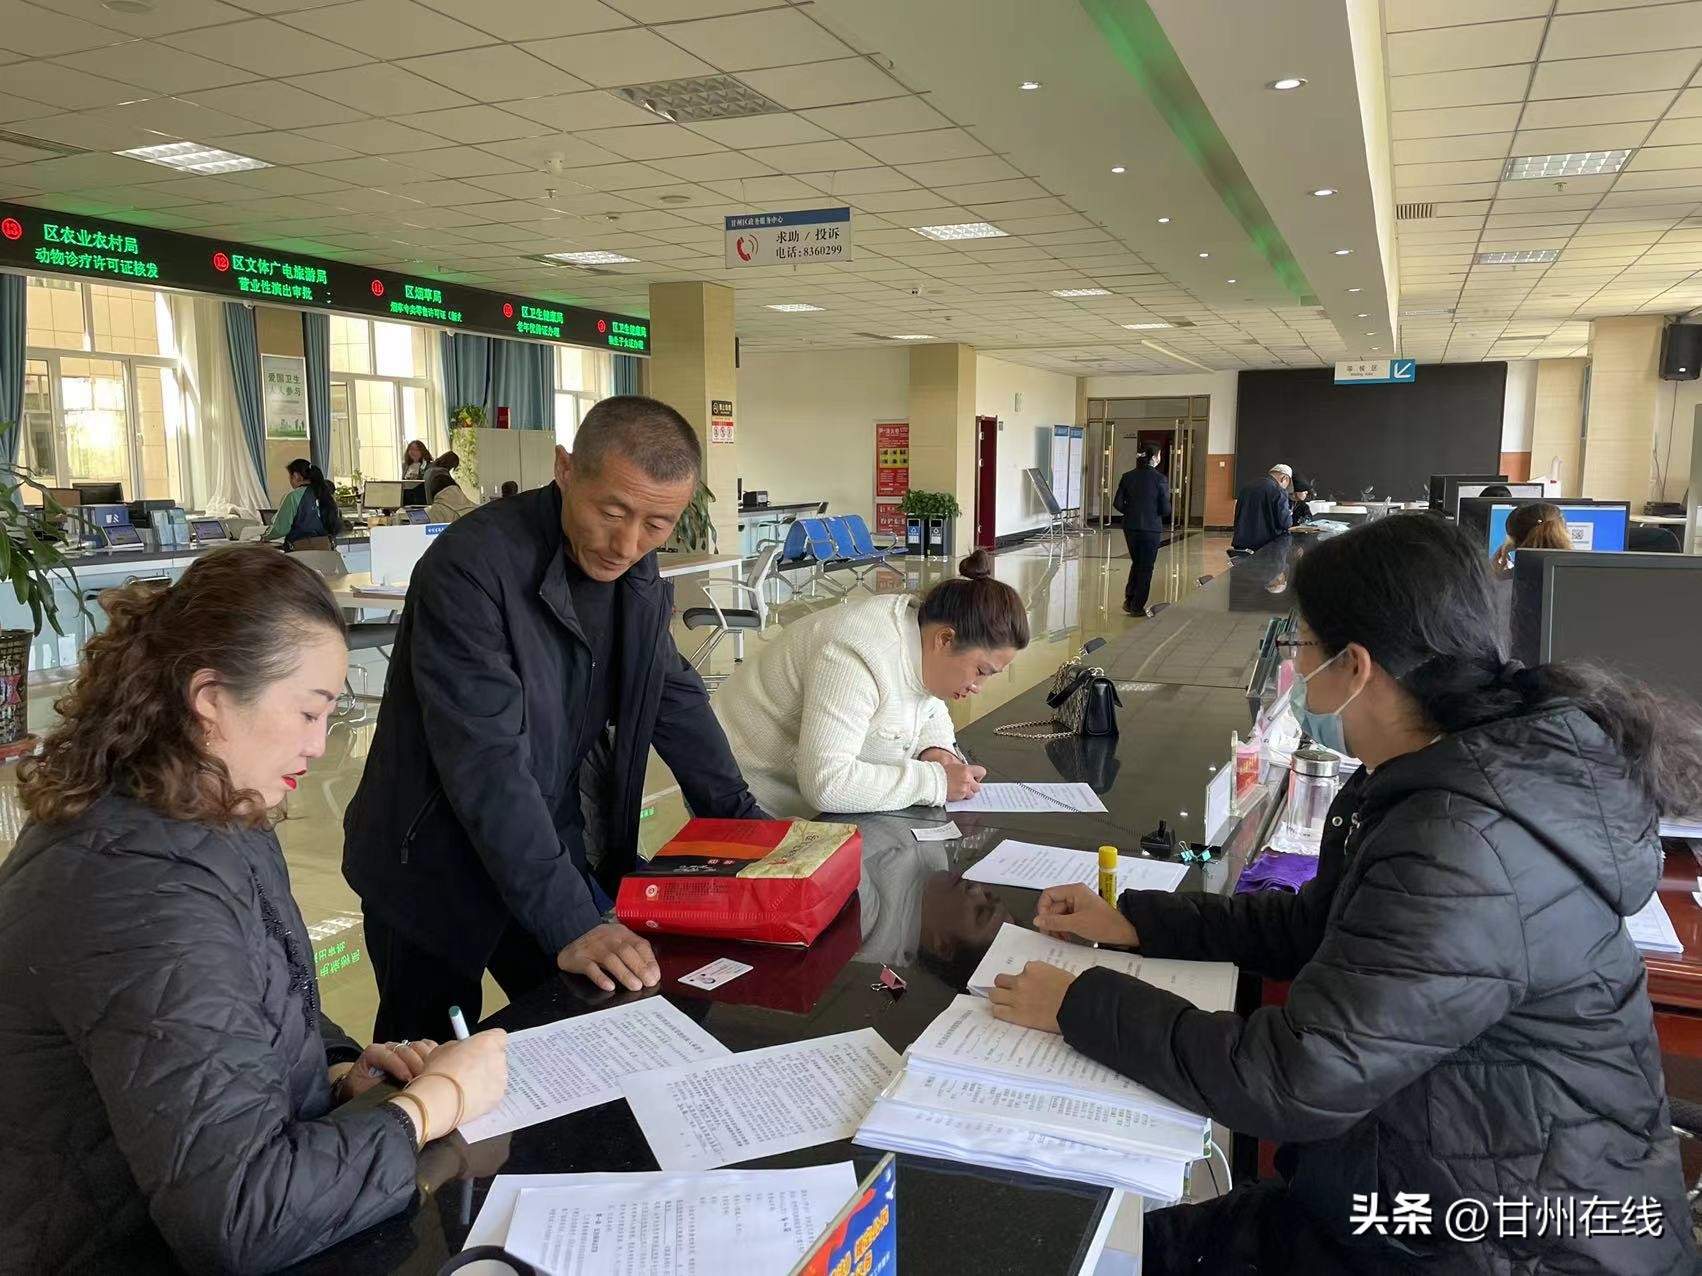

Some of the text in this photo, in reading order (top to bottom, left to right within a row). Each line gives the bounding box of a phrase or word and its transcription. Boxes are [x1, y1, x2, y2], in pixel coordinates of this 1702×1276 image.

[43, 223, 139, 255] 区农业农村局
[776, 230, 800, 244] 求助
[815, 227, 840, 241] 投诉
[34, 247, 159, 279] 动物诊疗许可证核发
[231, 254, 327, 285] 区文体广电旅游局
[238, 276, 313, 300] 营业性演出审批
[268, 372, 301, 384] 爱国卫生
[270, 386, 301, 397] 人人参与
